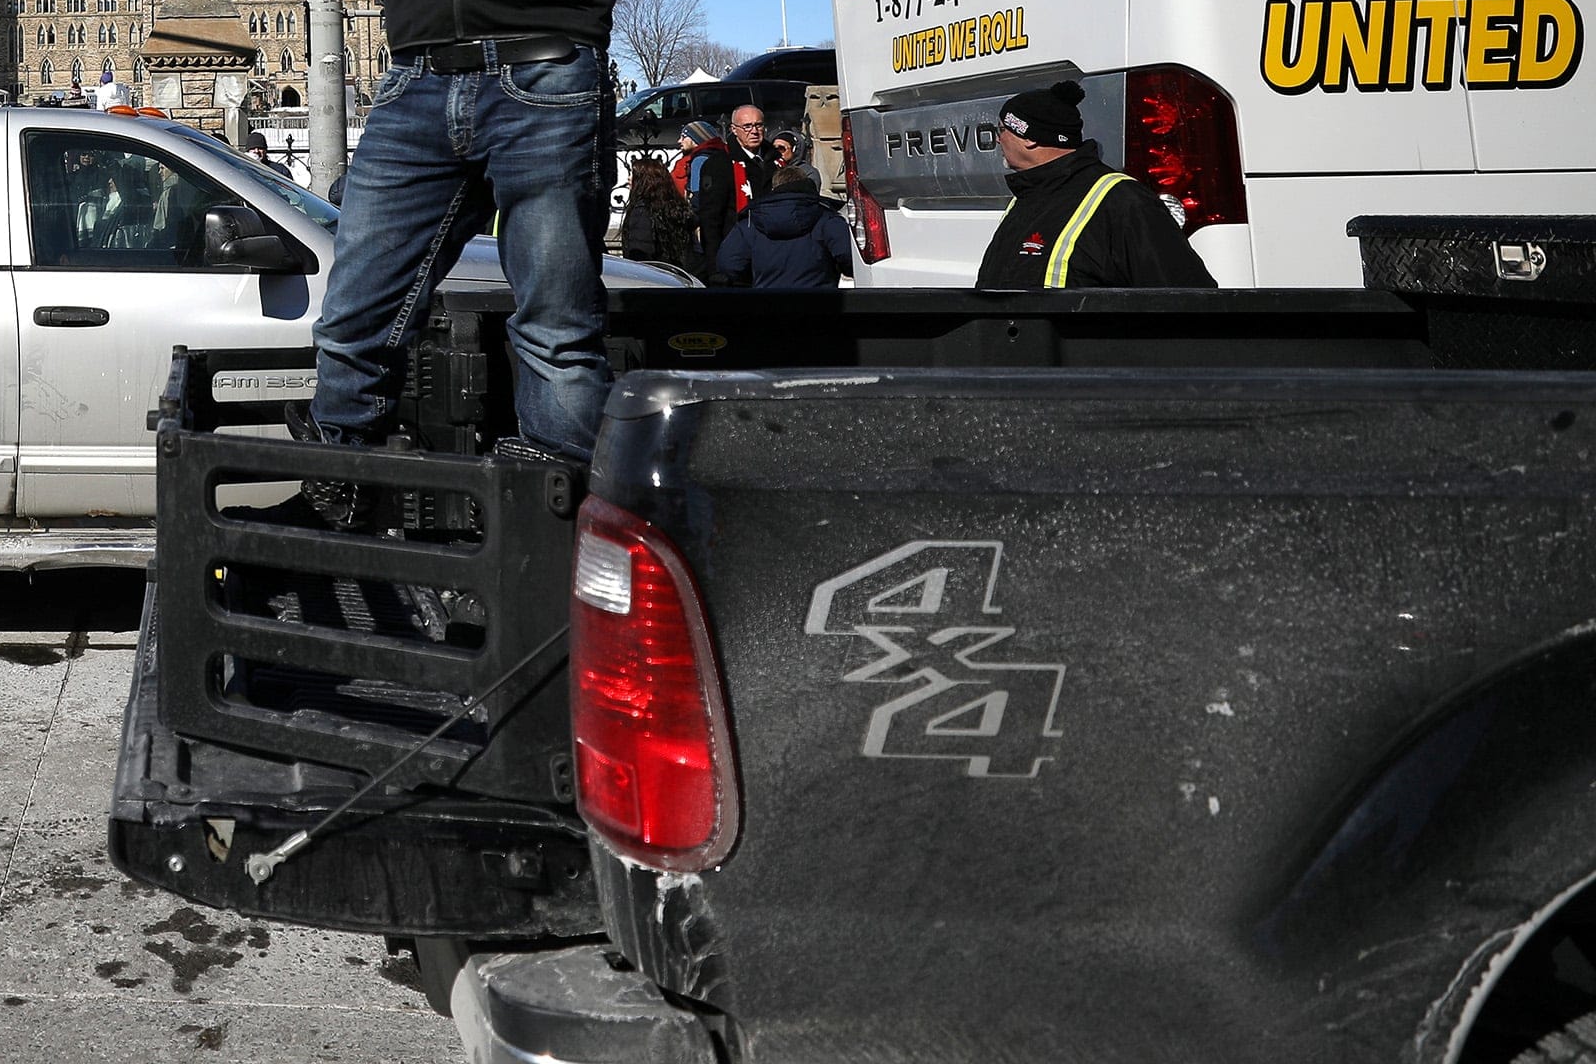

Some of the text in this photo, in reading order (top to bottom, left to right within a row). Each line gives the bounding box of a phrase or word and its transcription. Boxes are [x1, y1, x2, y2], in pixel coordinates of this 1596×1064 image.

[892, 6, 1029, 74] UNITED WE ROLL
